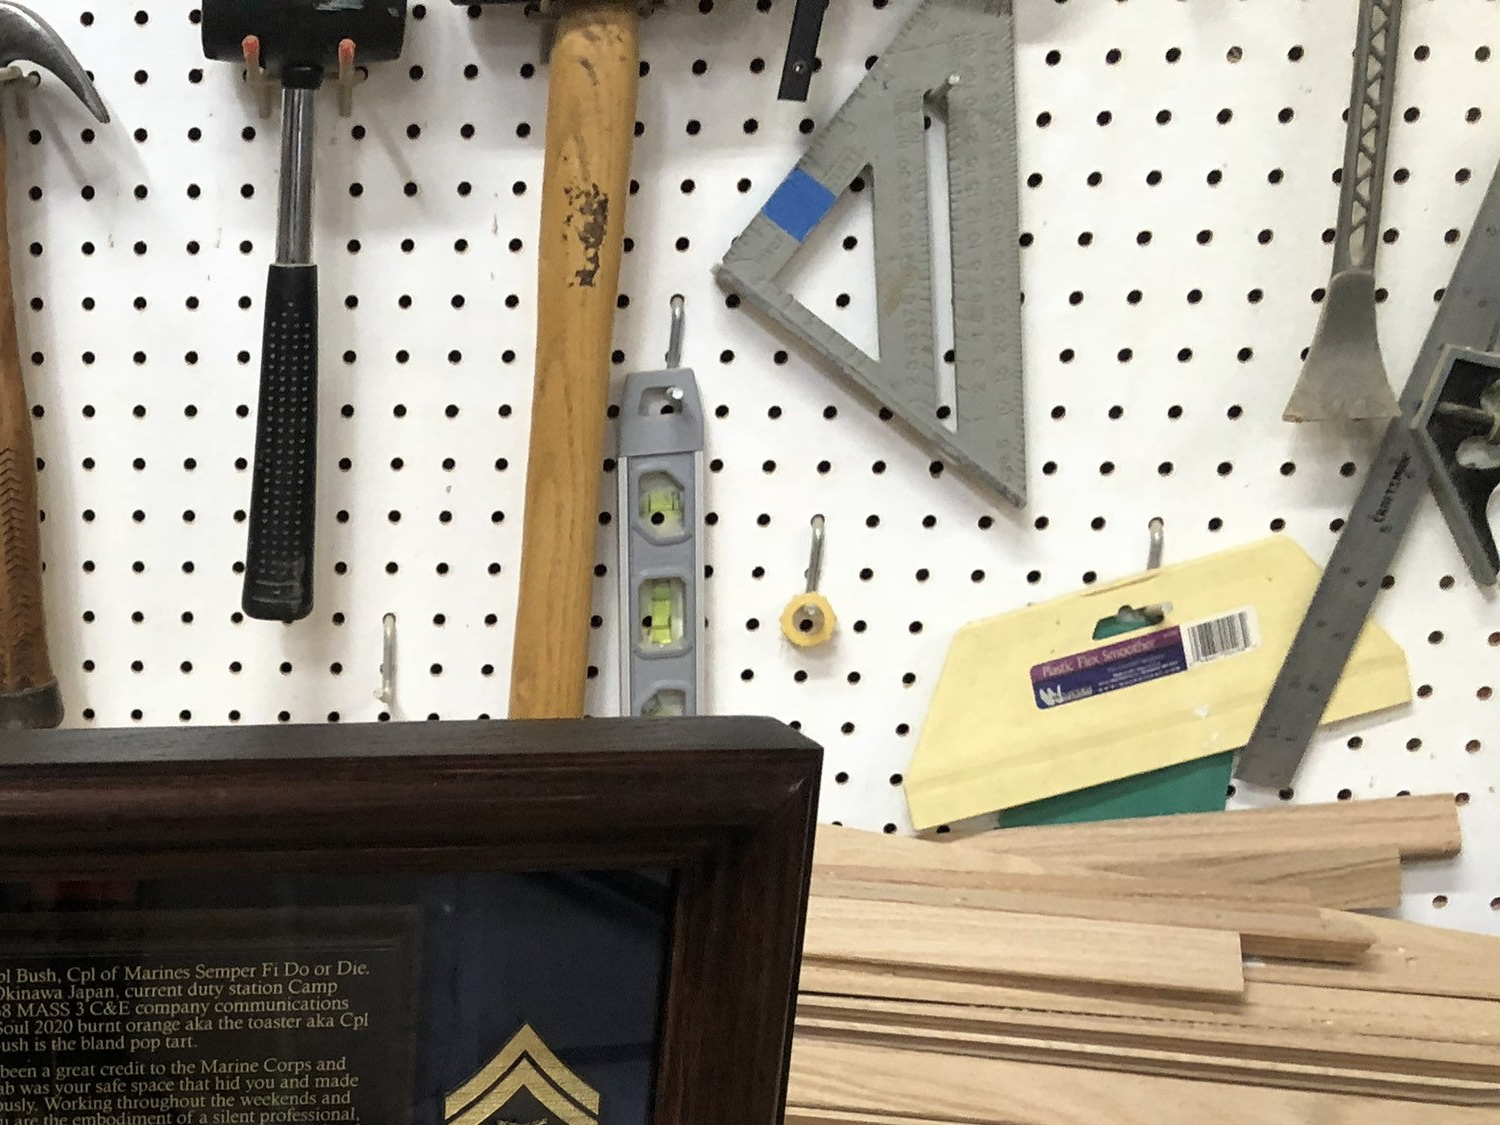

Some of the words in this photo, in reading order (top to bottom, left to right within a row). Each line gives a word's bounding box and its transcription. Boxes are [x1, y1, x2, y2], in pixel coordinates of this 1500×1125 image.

[1042, 661, 1075, 677] Plastic
[1077, 655, 1100, 669] Flex
[1101, 639, 1156, 661] Smoother
[16, 967, 61, 984] Bush,
[66, 966, 95, 985] Cpl
[100, 966, 117, 980] of
[124, 964, 190, 980] Marines
[195, 963, 257, 982] Semper
[262, 962, 278, 977] Fi
[284, 961, 310, 976] Do
[313, 965, 332, 976] or
[336, 960, 370, 975] Die.
[67, 983, 119, 1002] Japan,
[124, 982, 183, 997] current
[187, 981, 223, 1000] duty
[228, 980, 283, 995] station
[288, 978, 338, 998] Camp
[17, 1002, 70, 1017] MASS
[75, 1002, 84, 1016] 3
[89, 1000, 130, 1015] C&E
[135, 1003, 210, 1018] company
[214, 996, 349, 1013] communications
[34, 1019, 73, 1034] 2020
[77, 1018, 121, 1033] burnt
[125, 1020, 180, 1036] orange
[184, 1016, 213, 1031] aka
[218, 1015, 243, 1030] the
[247, 1014, 302, 1029] toaster
[306, 1013, 334, 1028] aka
[339, 1012, 368, 1031] Cpl
[34, 1036, 47, 1051] is
[51, 1036, 76, 1051] the
[80, 1035, 125, 1050] bland
[130, 1038, 161, 1053] pop
[165, 1033, 197, 1048] tart.
[0, 1064, 37, 1078] been
[41, 1067, 51, 1077] a
[56, 1062, 95, 1081] great
[99, 1061, 145, 1076] credit
[150, 1061, 166, 1075] to
[170, 1060, 196, 1074] the
[201, 1059, 259, 1073] Marine
[263, 1057, 312, 1076] Corps
[316, 1057, 346, 1071] and
[45, 1096, 112, 1115] Working
[116, 1093, 205, 1113] throughout
[210, 1093, 235, 1107] the
[239, 1091, 317, 1106] weekends
[321, 1090, 351, 1104] and
